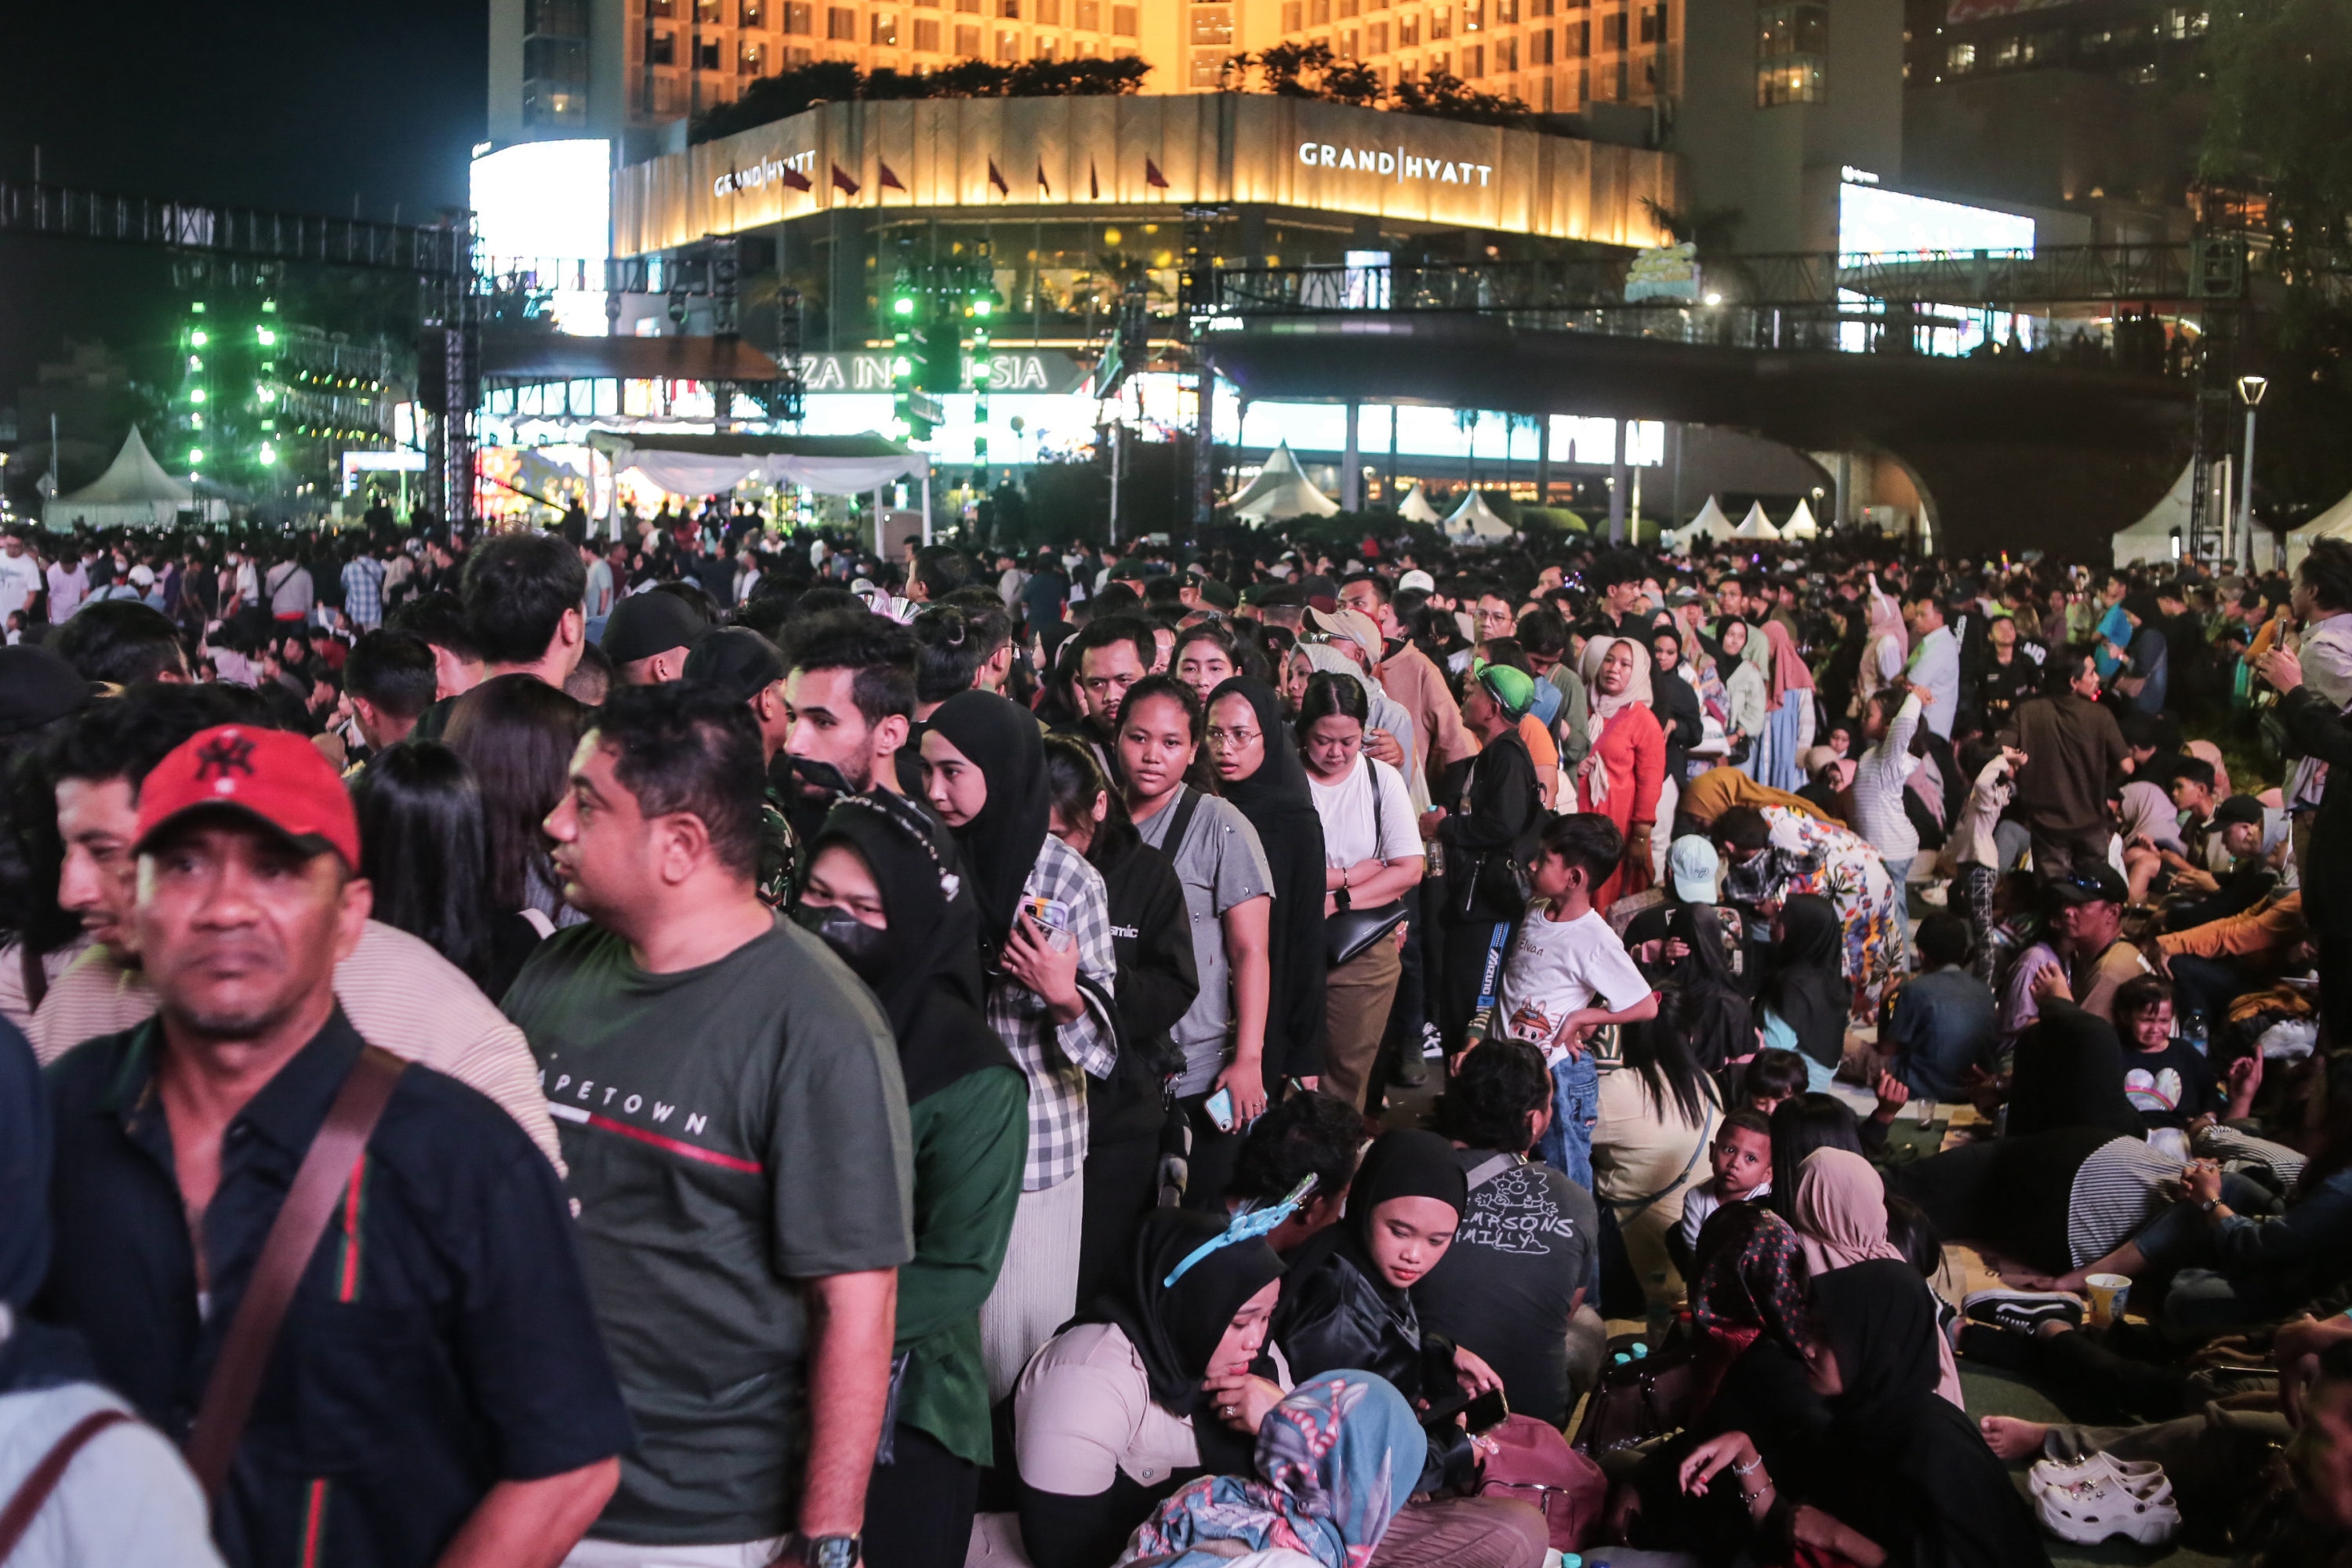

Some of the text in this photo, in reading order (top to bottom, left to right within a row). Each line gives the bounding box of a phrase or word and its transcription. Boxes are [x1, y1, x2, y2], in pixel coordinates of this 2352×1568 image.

[1299, 142, 1492, 187] GRAND HYATT
[1482, 947, 1499, 995] MIZUNO
[1462, 1211, 1574, 1238] MPSONS
